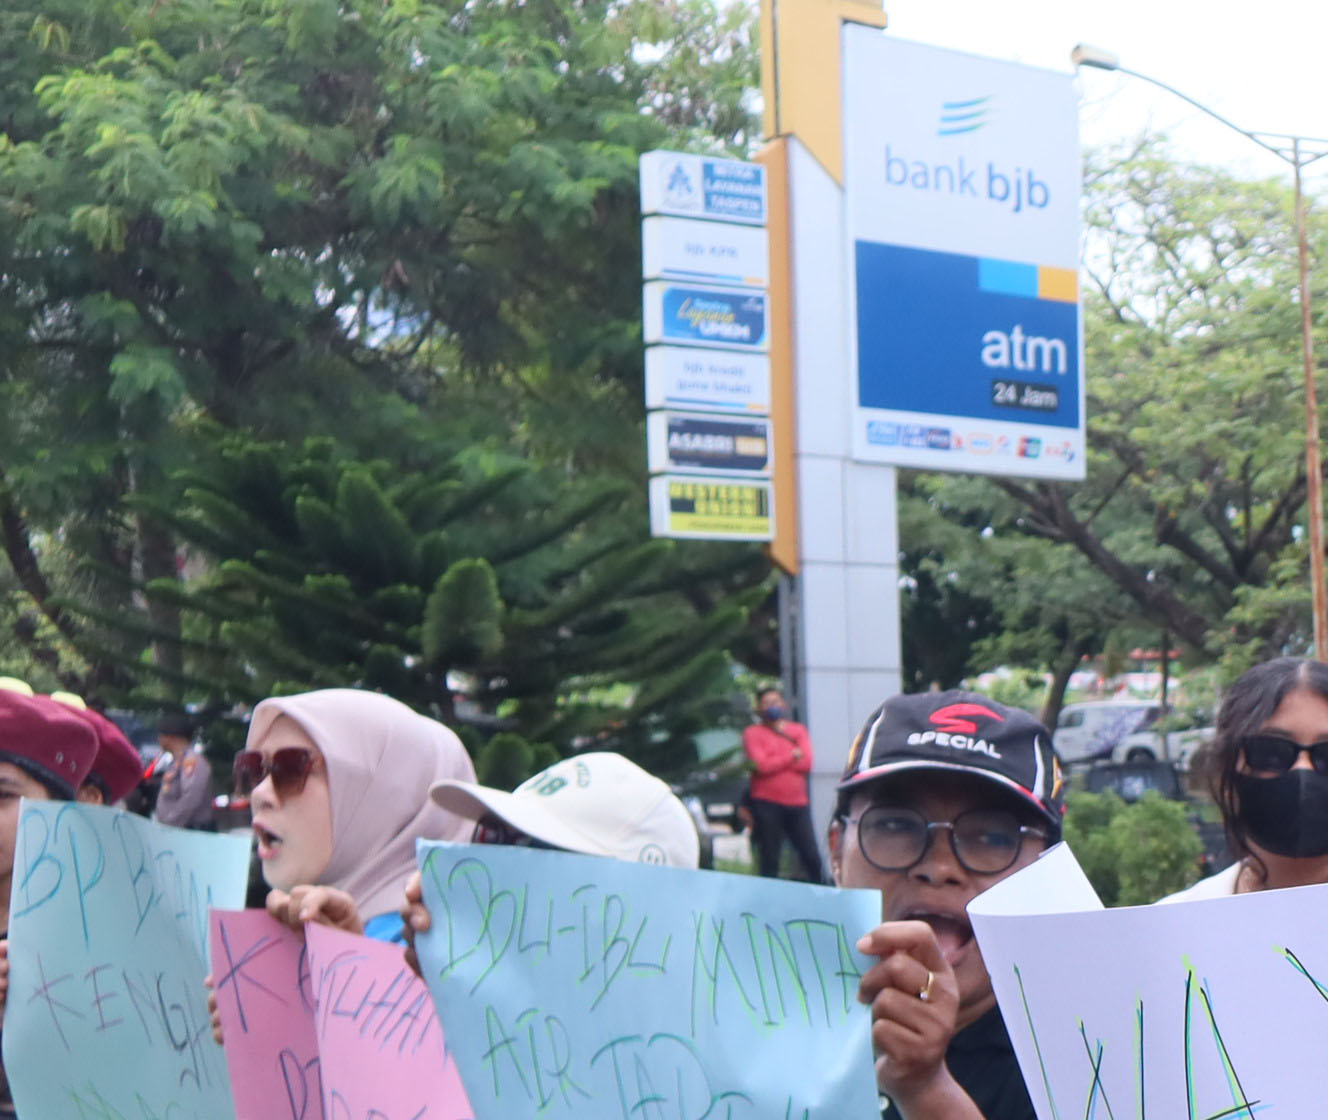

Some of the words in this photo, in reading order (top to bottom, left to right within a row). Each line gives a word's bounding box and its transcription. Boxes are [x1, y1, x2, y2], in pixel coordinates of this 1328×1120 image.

[884, 146, 978, 198] bank
[988, 162, 1050, 213] bjb
[980, 324, 1068, 374] atm
[992, 382, 1017, 402] 24
[1020, 385, 1058, 407] Jam
[906, 731, 1002, 759] SPECIAL
[481, 1003, 594, 1120] AIR
